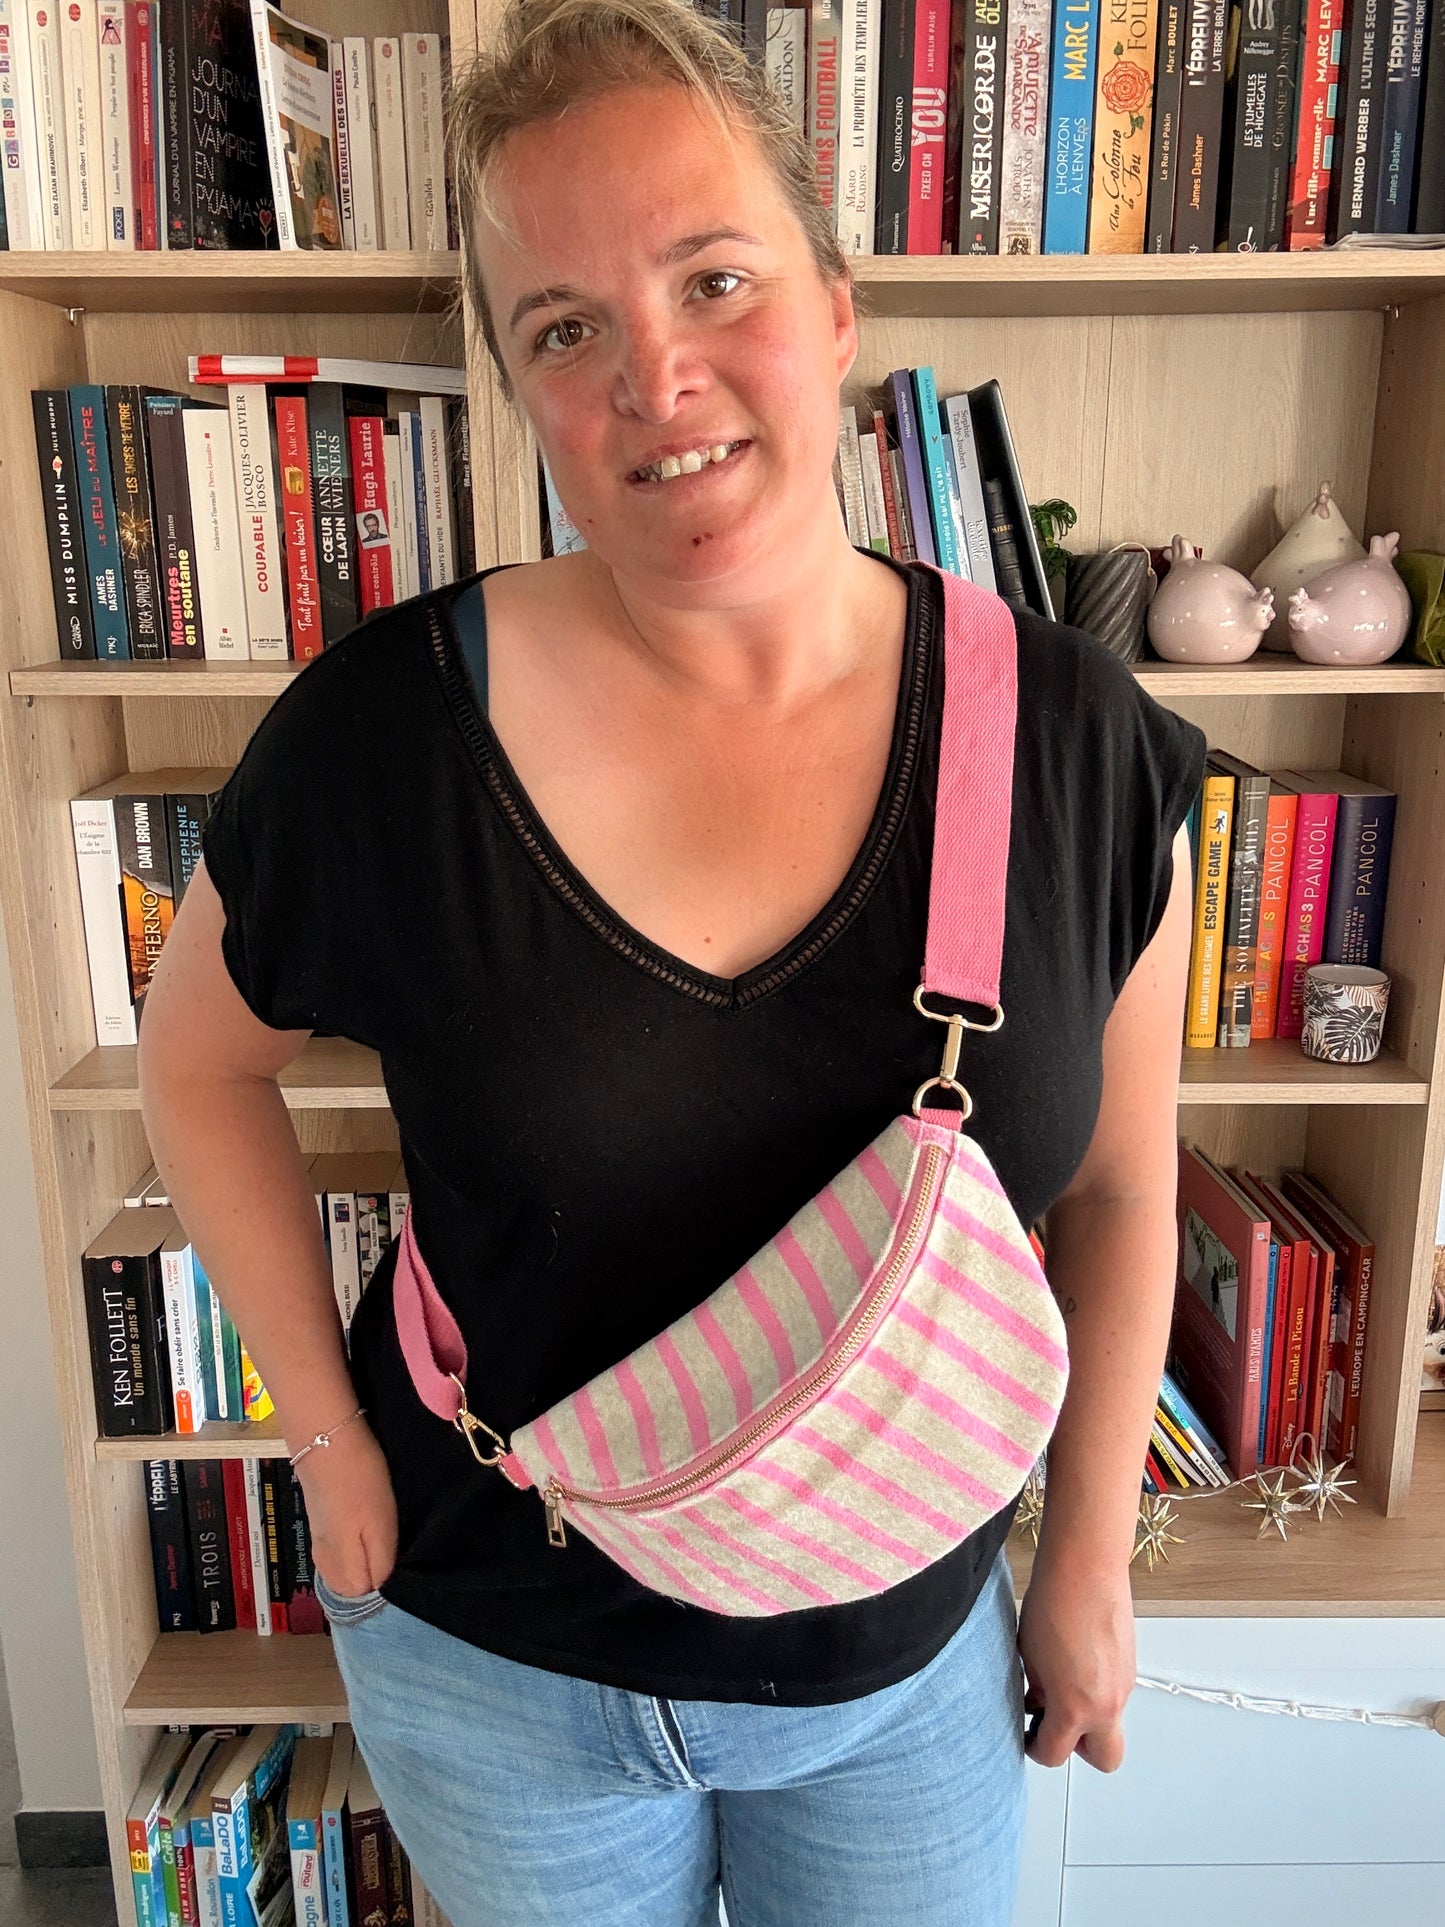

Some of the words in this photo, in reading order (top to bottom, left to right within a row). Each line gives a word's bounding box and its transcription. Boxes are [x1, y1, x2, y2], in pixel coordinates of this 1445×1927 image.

[928, 10, 936, 33] PAIGE
[1167, 5, 1178, 46] BOULET
[140, 41, 148, 86] GYNÉCOLOGUE
[167, 47, 176, 83] PYJAMA
[351, 50, 359, 70] Coelho
[855, 55, 867, 72] DES
[927, 35, 935, 72] LAURELIN
[1063, 21, 1089, 80] MARC
[1166, 48, 1176, 73] Marc
[1315, 34, 1330, 82] MARC
[141, 88, 149, 103] D'UN
[169, 85, 177, 98] EN
[334, 70, 344, 105] GEEKS
[352, 72, 360, 88] Paulo
[815, 36, 837, 130] FOOTBALL
[851, 76, 867, 131] PROPHÉTIE
[1245, 74, 1257, 126] JUMELLES
[1255, 73, 1267, 130] HIGHGATE
[1313, 97, 1324, 122] elle
[142, 104, 150, 145] CONFIDENCES
[169, 99, 178, 137] VAMPIRE
[337, 108, 346, 129] DES
[911, 87, 946, 147] YOU
[970, 35, 997, 220] MISERICORDE
[1162, 113, 1172, 138] Pékin
[1355, 98, 1370, 154] WERBER
[170, 138, 179, 160] D'UN
[853, 136, 864, 147] LA
[891, 97, 905, 172] QUATTROCENTO
[1072, 117, 1089, 180] L'ENVERS
[1162, 140, 1170, 152] de
[1243, 128, 1254, 147] LES
[1254, 132, 1264, 147] DE
[1312, 124, 1323, 170] comme
[1389, 130, 1402, 171] Dashner
[47, 133, 58, 176] IBRAHIMOVIĆ
[79, 152, 87, 176] Gilbert
[339, 132, 349, 184] SEXUELLE
[921, 153, 932, 167] ON
[1055, 117, 1071, 195] L'HORIZON
[1102, 129, 1121, 199] Colonne
[1161, 153, 1170, 167] Roi
[1192, 134, 1204, 175] Dashner
[51, 178, 59, 201] ZLATAN
[171, 163, 182, 204] JOURNAL
[846, 170, 857, 207] MARIO
[856, 165, 867, 213] READING
[920, 170, 932, 199] FIXED
[1012, 155, 1022, 201] STROUD
[1022, 149, 1034, 209] JONATHAN
[1069, 185, 1083, 195] À
[1122, 154, 1142, 196] Feu
[1160, 169, 1169, 180] Le
[1307, 172, 1319, 199] fille
[1351, 156, 1366, 218] BERNARD
[1386, 174, 1399, 205] James
[80, 179, 89, 211] Elizabeth
[342, 188, 351, 204] VIE
[1122, 199, 1135, 210] de
[1189, 178, 1201, 210] James
[113, 207, 125, 240] POCKET
[344, 205, 352, 219] LA
[1109, 204, 1121, 231] Une
[1304, 200, 1317, 225] Une
[80, 406, 99, 471] MAÎTRE
[952, 412, 966, 469] Tardy-Joubert
[960, 409, 970, 439] Sophie
[236, 395, 255, 509] JACQUES-OLIVIER
[360, 422, 374, 468] Laurie
[430, 429, 440, 483] GLUCKSMANN
[315, 429, 332, 509] ANNETTE
[328, 435, 344, 508] WIENERS
[254, 464, 268, 508] BOSCO
[364, 471, 378, 508] Hugh
[433, 485, 443, 519] RAPHAËL
[55, 484, 73, 560] DUMPLIN
[90, 496, 106, 530] JEU
[320, 517, 335, 563] CŒUR
[334, 517, 348, 559] LAPIN
[436, 526, 444, 542] VIDE
[437, 543, 444, 553] DU
[252, 515, 269, 593] COUPABLE
[297, 548, 308, 562] un
[437, 555, 446, 585] ENFANTS
[62, 566, 78, 604] MISS
[176, 549, 194, 619] soutane
[296, 564, 314, 581] par
[336, 562, 350, 580] DE
[96, 575, 107, 605] JAMES
[106, 569, 118, 611] DASHNER
[133, 568, 152, 608] SPINDLER
[295, 583, 316, 606] finit
[137, 610, 155, 634] ERICA
[166, 566, 185, 645] Meurtres
[297, 607, 314, 631] Tout
[184, 625, 197, 645] en
[133, 802, 151, 842] BROWN
[137, 846, 153, 869] DAN
[176, 805, 192, 883] STEPHENIE
[1208, 840, 1223, 877] GAME
[1266, 817, 1290, 900] PANCOL
[1304, 816, 1329, 898] PANCOL
[1356, 817, 1380, 895] PANCOL
[1204, 881, 1220, 930] ESCAPE
[1231, 981, 1247, 1011] THE
[1240, 817, 1259, 874] FAMILY
[1201, 976, 1212, 993] LIVRE
[1202, 963, 1212, 975] DES
[1200, 995, 1211, 1016] GRAND
[125, 1297, 137, 1310] fin
[171, 1299, 180, 1317] crier
[1356, 1257, 1372, 1330] CAMPING-CAR
[102, 1288, 128, 1362] FOLLETT
[127, 1314, 139, 1339] sans
[173, 1318, 181, 1335] sans
[1291, 1307, 1305, 1341] Picsou
[1354, 1332, 1365, 1346] EN
[174, 1336, 183, 1357] obéir
[1250, 1328, 1262, 1356] D'AMIES
[130, 1343, 142, 1378] monde
[176, 1359, 185, 1375] faire
[1248, 1360, 1260, 1382] PARIS
[1287, 1353, 1301, 1385] Bande
[1350, 1348, 1364, 1397] L'EUROPE
[112, 1369, 134, 1406] KEN
[132, 1382, 145, 1396] Un
[178, 1377, 186, 1386] Se
[1287, 1386, 1299, 1402] La
[199, 1531, 221, 1588] TROIS
[253, 1543, 262, 1567] Devenir
[162, 1832, 174, 1864] Crète
[176, 1848, 184, 1867] 100%
[217, 1816, 233, 1875] BaLaDO
[180, 1871, 188, 1894] YORK
[303, 1855, 314, 1888] routard
[225, 1893, 236, 1921] LOIRE
